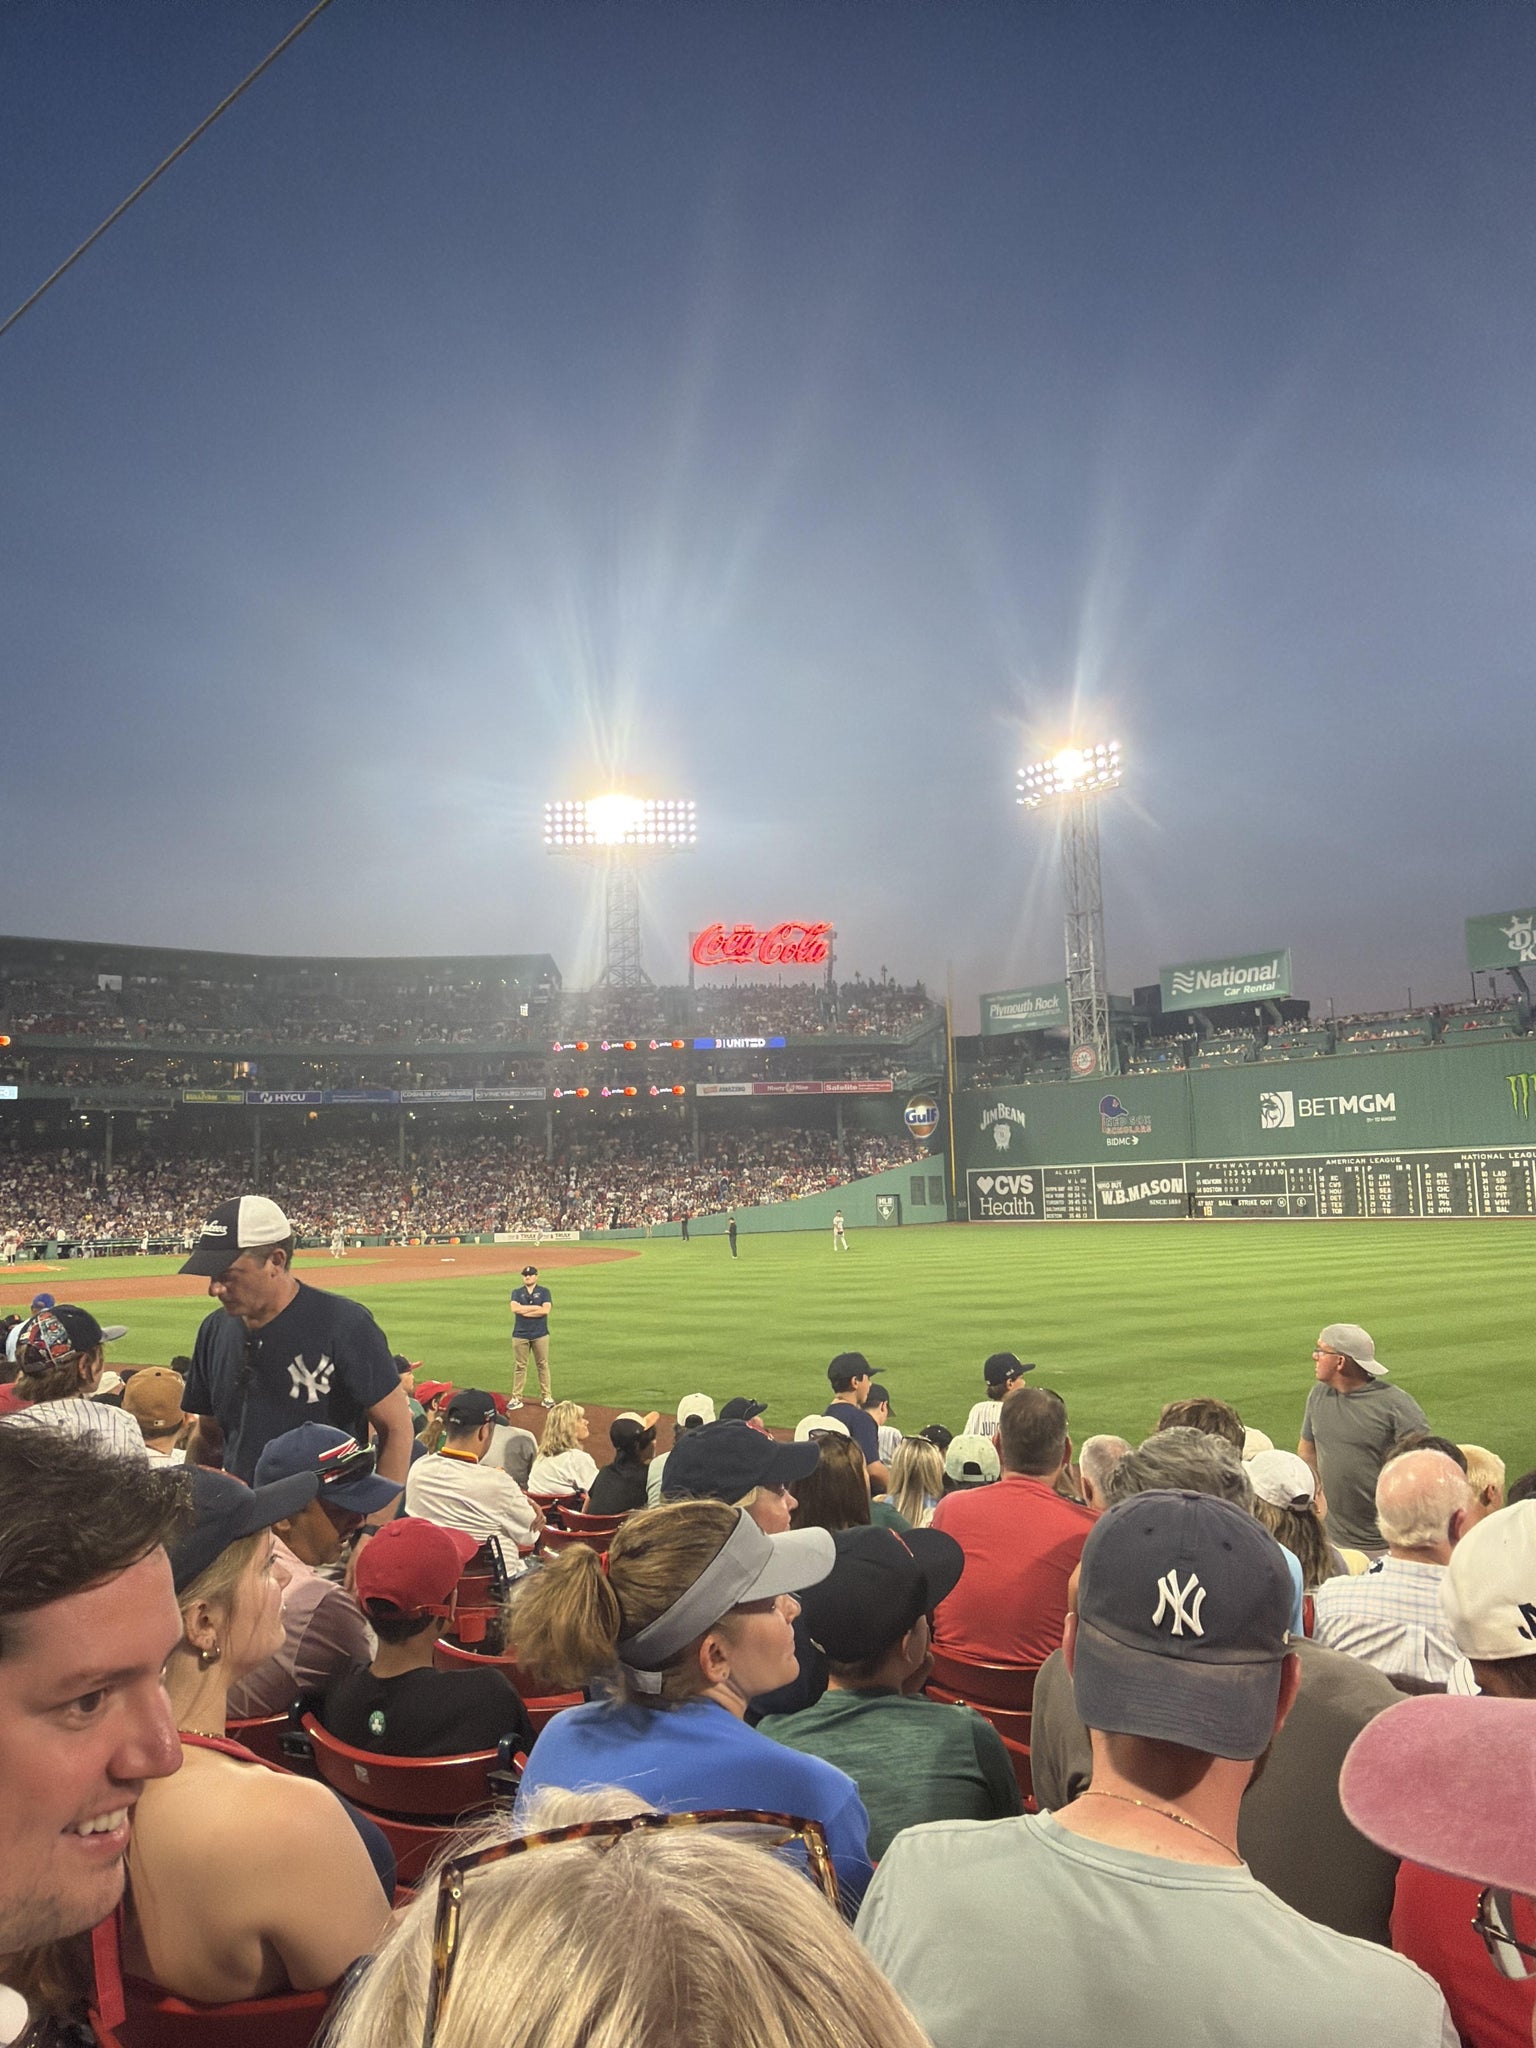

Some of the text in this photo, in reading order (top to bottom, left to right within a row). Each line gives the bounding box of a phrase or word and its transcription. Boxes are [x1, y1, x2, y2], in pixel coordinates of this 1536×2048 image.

[1224, 982, 1275, 996] Car Rental
[990, 1000, 1032, 1017] Plymouth
[1035, 995, 1059, 1011] Rock
[1299, 1093, 1396, 1116] BETMGM
[905, 1108, 936, 1123] Gulf
[980, 1103, 1026, 1130] JIM BEAM
[1107, 1138, 1131, 1146] BIDMC
[995, 1175, 1034, 1195] CVS
[980, 1197, 1035, 1215] Health
[288, 1354, 335, 1403] NY
[1152, 1569, 1206, 1636] NY
